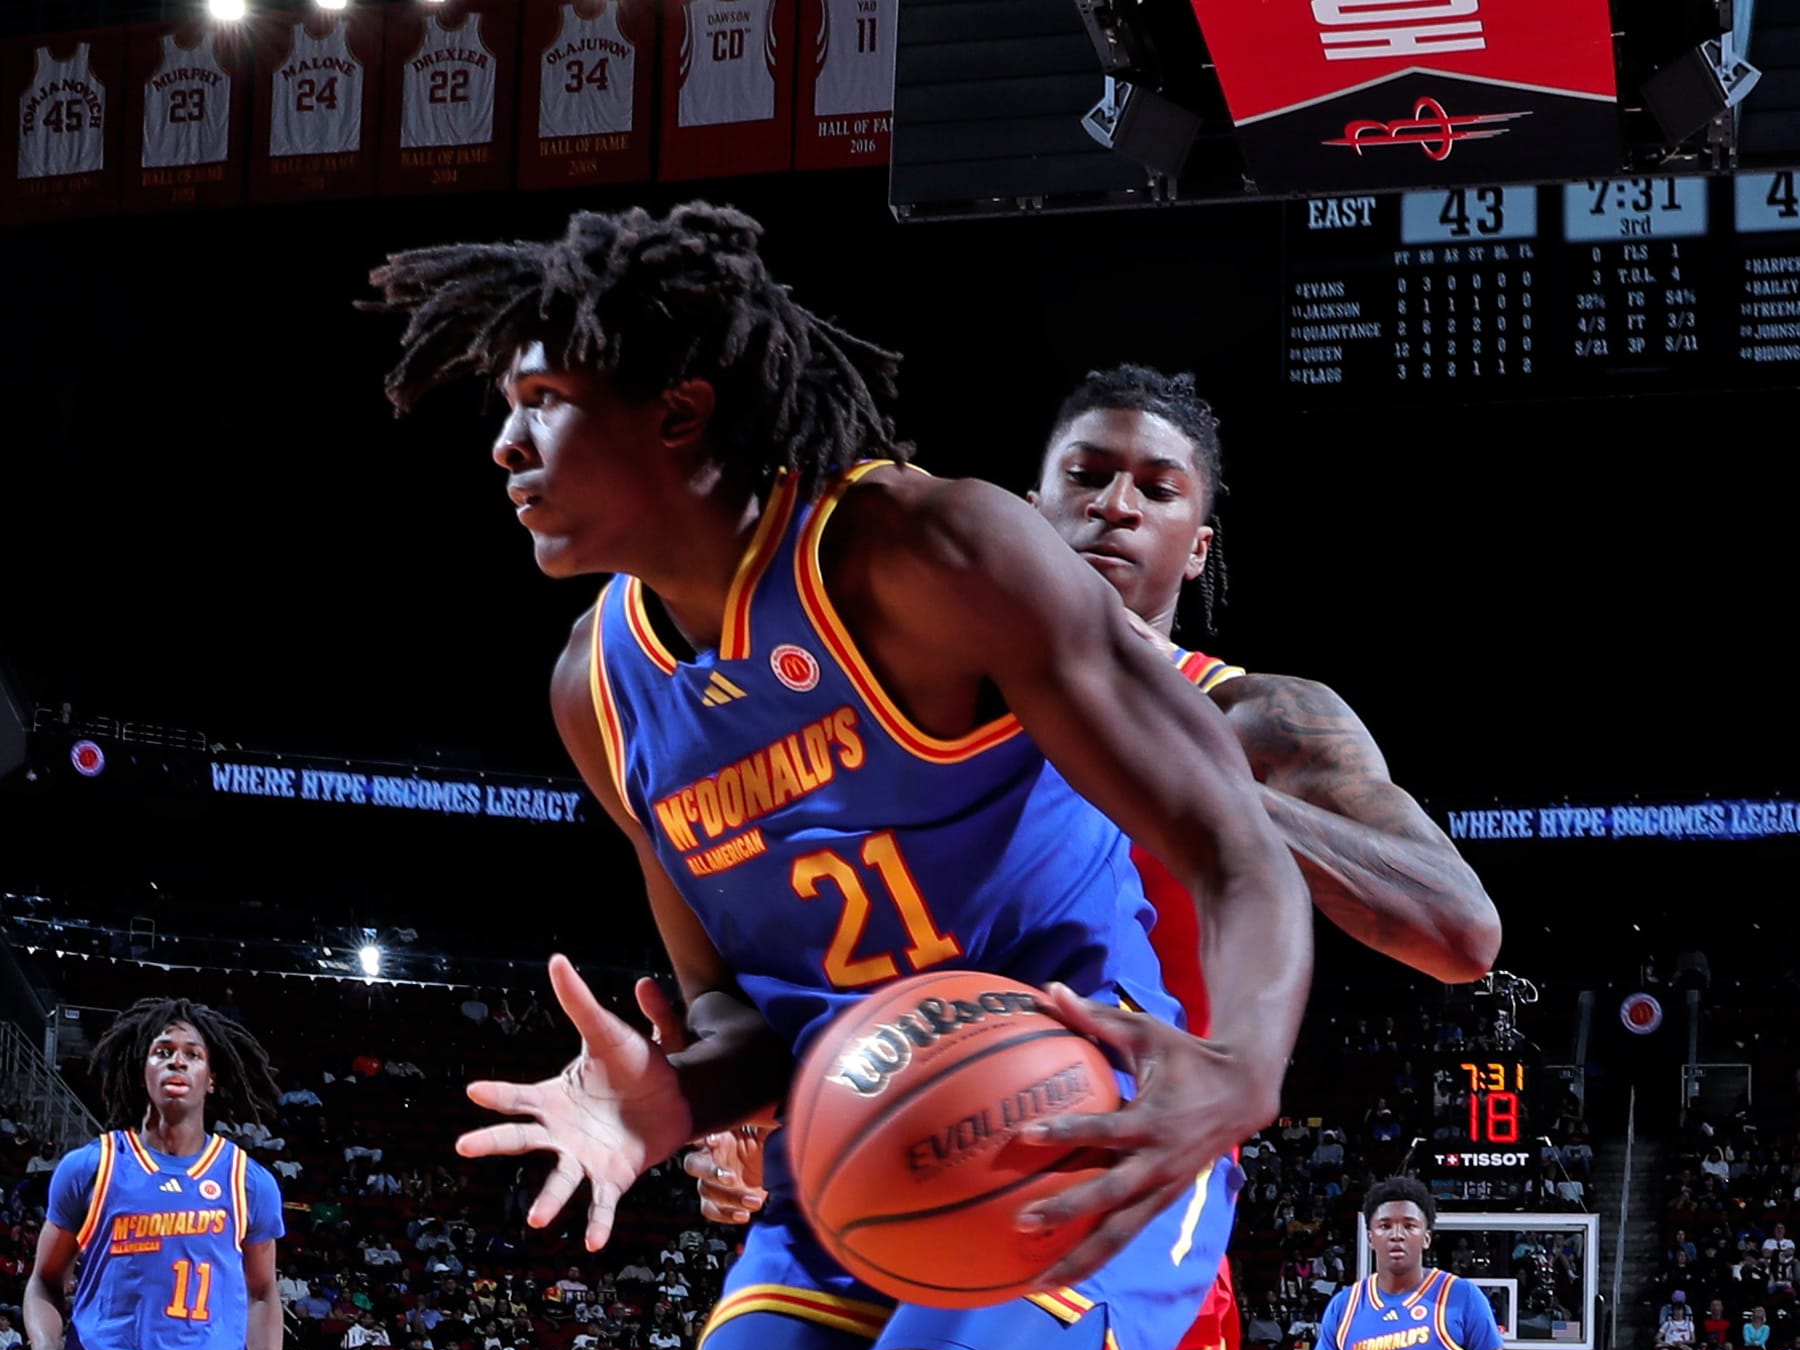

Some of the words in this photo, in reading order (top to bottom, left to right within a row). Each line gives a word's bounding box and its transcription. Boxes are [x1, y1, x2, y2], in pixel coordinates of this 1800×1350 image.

[707, 11, 751, 26] DAWSON
[857, 1, 877, 12] YAO
[857, 18, 877, 53] 11
[412, 48, 489, 73] DREXLER
[546, 37, 630, 65] OLAJUWON
[152, 68, 223, 92] MURPHY
[281, 57, 357, 82] MALONE
[565, 57, 609, 94] 34
[296, 77, 339, 112] 24
[429, 70, 471, 104] 22
[23, 78, 102, 136] TOMJANOVICH
[43, 100, 83, 133] 45
[169, 89, 205, 124] 23
[818, 120, 850, 137] HALL
[853, 119, 870, 135] OF
[873, 117, 893, 133] FA
[539, 138, 574, 157] HALL
[576, 137, 594, 154] OF
[595, 134, 629, 152] FAME
[849, 139, 877, 154] 2016
[1587, 177, 1682, 215] 7:31
[1307, 196, 1376, 230] EAST
[1439, 187, 1504, 237] 43
[1620, 215, 1652, 236] 3rd
[1444, 248, 1459, 262] AS
[1468, 246, 1484, 261] ST
[1592, 246, 1601, 262] 0
[1672, 243, 1679, 258] 1
[1302, 281, 1345, 299] EVANS
[1398, 277, 1406, 293] 0
[1423, 276, 1431, 292] 3
[1448, 275, 1456, 290] 0
[1473, 273, 1481, 289] 0
[1498, 272, 1506, 288] 0
[1523, 271, 1531, 287] 0
[1593, 270, 1601, 286] 3
[1672, 265, 1680, 281] 4
[1752, 278, 1799, 296] BAILEY
[1303, 301, 1360, 320] JACKSON
[1424, 298, 1430, 313] 1
[1448, 297, 1455, 312] 1
[1473, 295, 1480, 311] 1
[1498, 294, 1506, 309] 0
[1523, 293, 1531, 308] 0
[1303, 321, 1381, 342] QUAINTANCE
[1498, 316, 1506, 331] 0
[1523, 314, 1531, 330] 0
[1303, 345, 1343, 363] QUEEN
[1423, 341, 1431, 356] 4
[1498, 337, 1506, 353] 0
[1523, 336, 1531, 351] 0
[1398, 364, 1406, 379] 3
[1473, 360, 1480, 376] 1
[1498, 359, 1505, 374] 1
[209, 761, 297, 800] WHERE
[301, 768, 367, 805] HYPE
[372, 772, 482, 815] BECOMES
[653, 705, 867, 853] McDONALD'S
[1448, 808, 1534, 840] WHERE
[1538, 805, 1606, 839] HYPE
[1611, 803, 1725, 840] BECOMES
[685, 851, 709, 878] ALL
[707, 827, 767, 873] AMERICAN
[790, 827, 963, 988] 21
[825, 991, 1038, 1098] Wilson
[1459, 1062, 1525, 1092] 7:31
[1469, 1092, 1520, 1144] 18
[1459, 1152, 1530, 1167] TISSOT
[112, 1209, 227, 1241] McDONALD'S
[165, 1259, 211, 1322] 11
